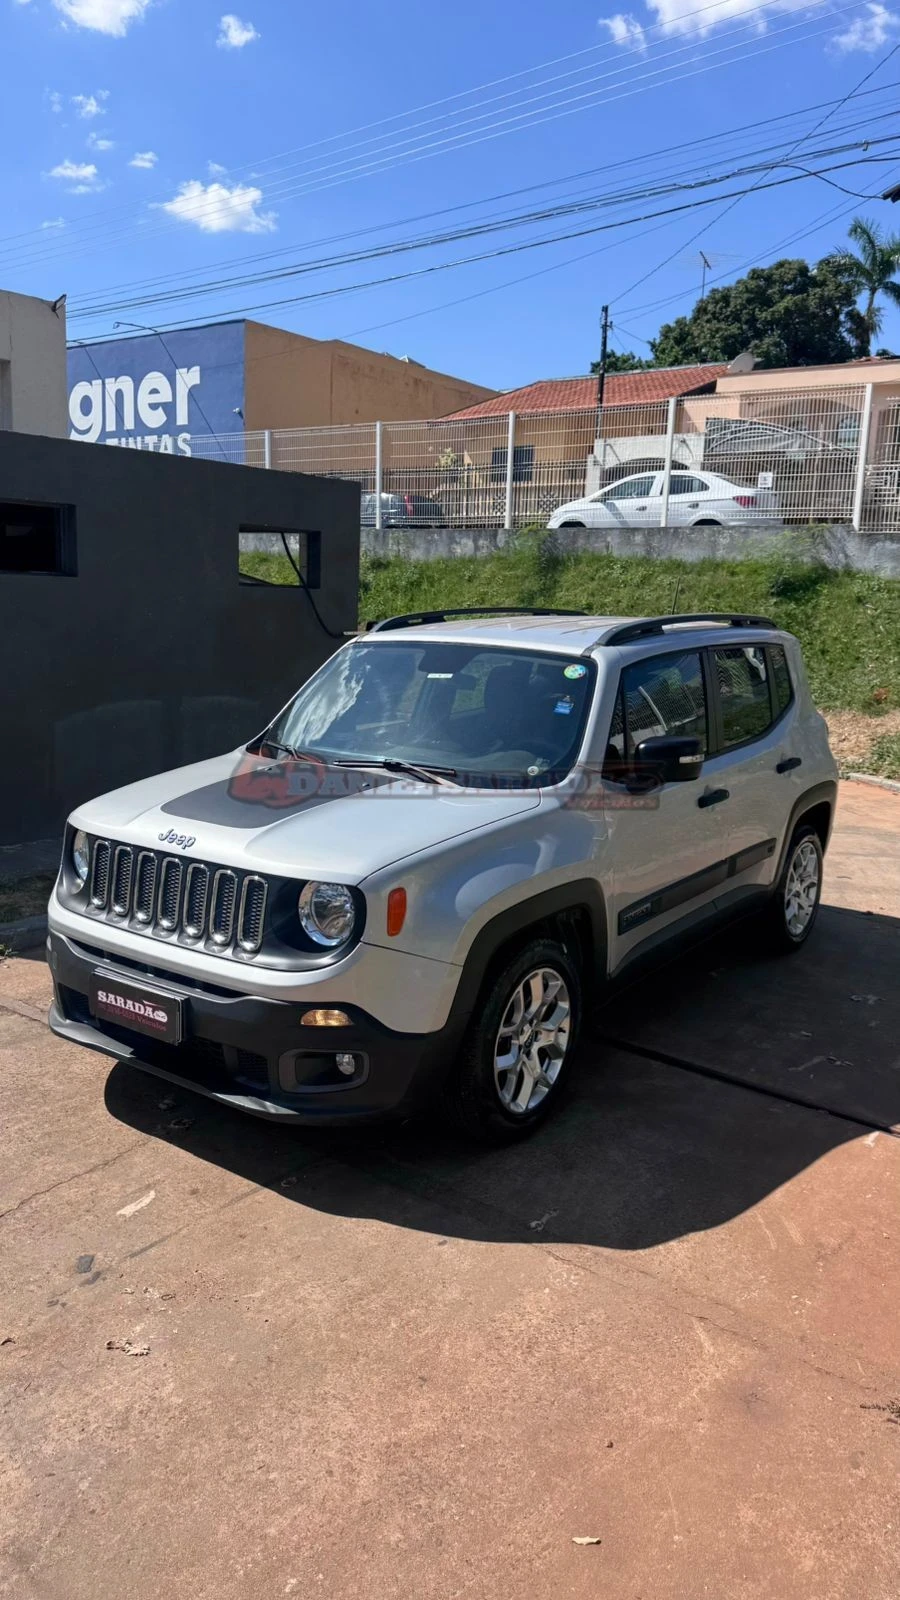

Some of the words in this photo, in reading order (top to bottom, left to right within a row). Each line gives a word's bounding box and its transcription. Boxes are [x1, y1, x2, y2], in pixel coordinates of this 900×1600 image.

[68, 365, 200, 444] gner
[158, 828, 196, 850] Jeep
[97, 990, 155, 1018] SARADA
